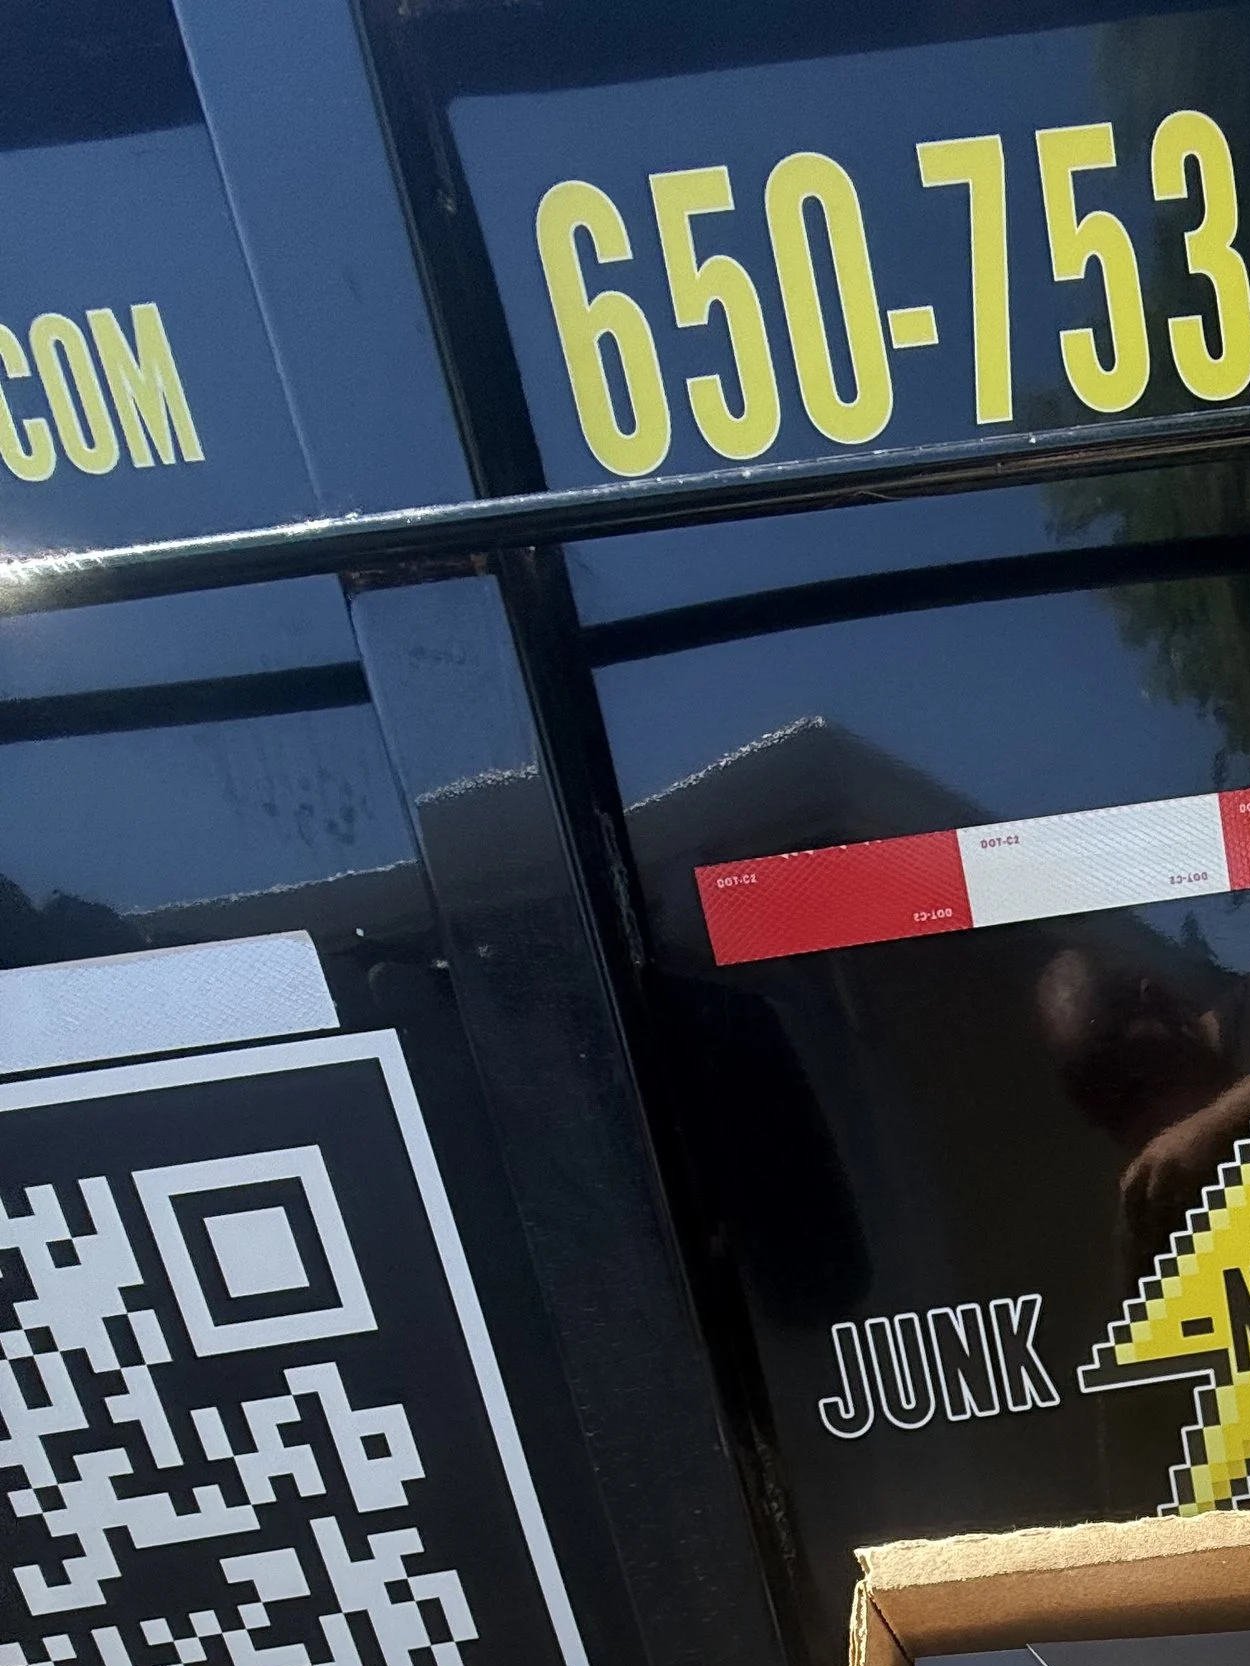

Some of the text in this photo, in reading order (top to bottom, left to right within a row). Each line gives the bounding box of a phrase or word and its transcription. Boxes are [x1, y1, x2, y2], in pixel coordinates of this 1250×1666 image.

[980, 835, 1020, 849] DOT-C2
[716, 873, 757, 889] DOT-C2
[1170, 871, 1209, 885] DOT-C2
[914, 907, 953, 922] DOT-C2
[818, 1294, 1060, 1439] JUNK
